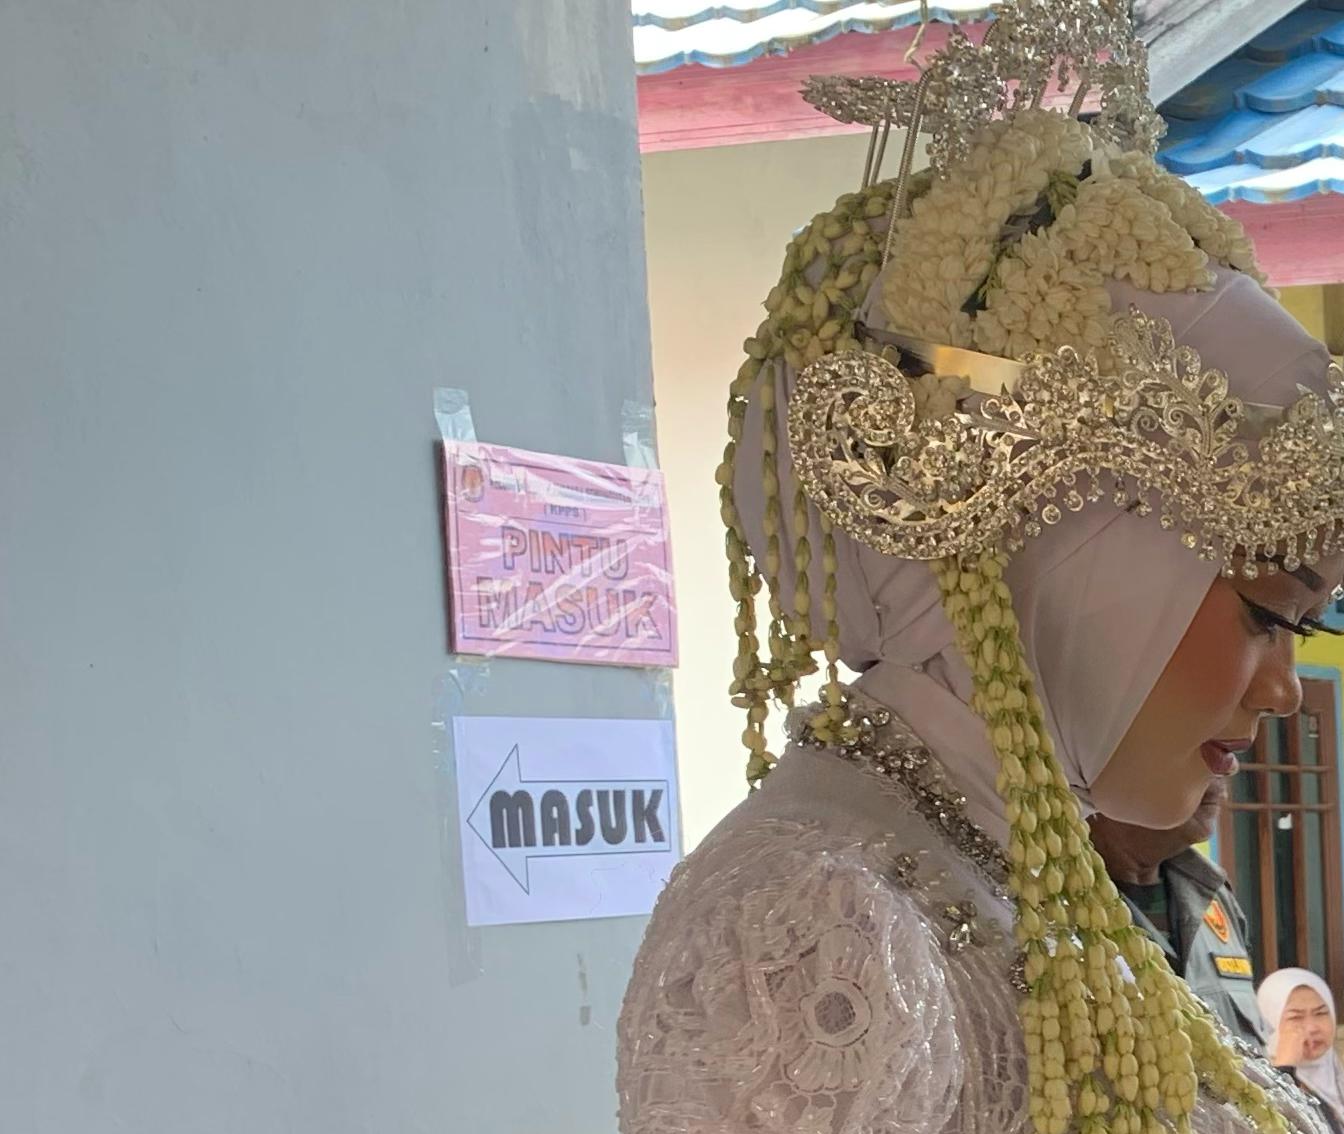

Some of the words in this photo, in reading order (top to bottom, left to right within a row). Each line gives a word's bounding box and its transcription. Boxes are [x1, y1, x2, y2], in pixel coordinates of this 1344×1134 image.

[501, 524, 629, 580] PINTU
[476, 576, 663, 640] MASUK
[489, 789, 666, 849] MASUK
